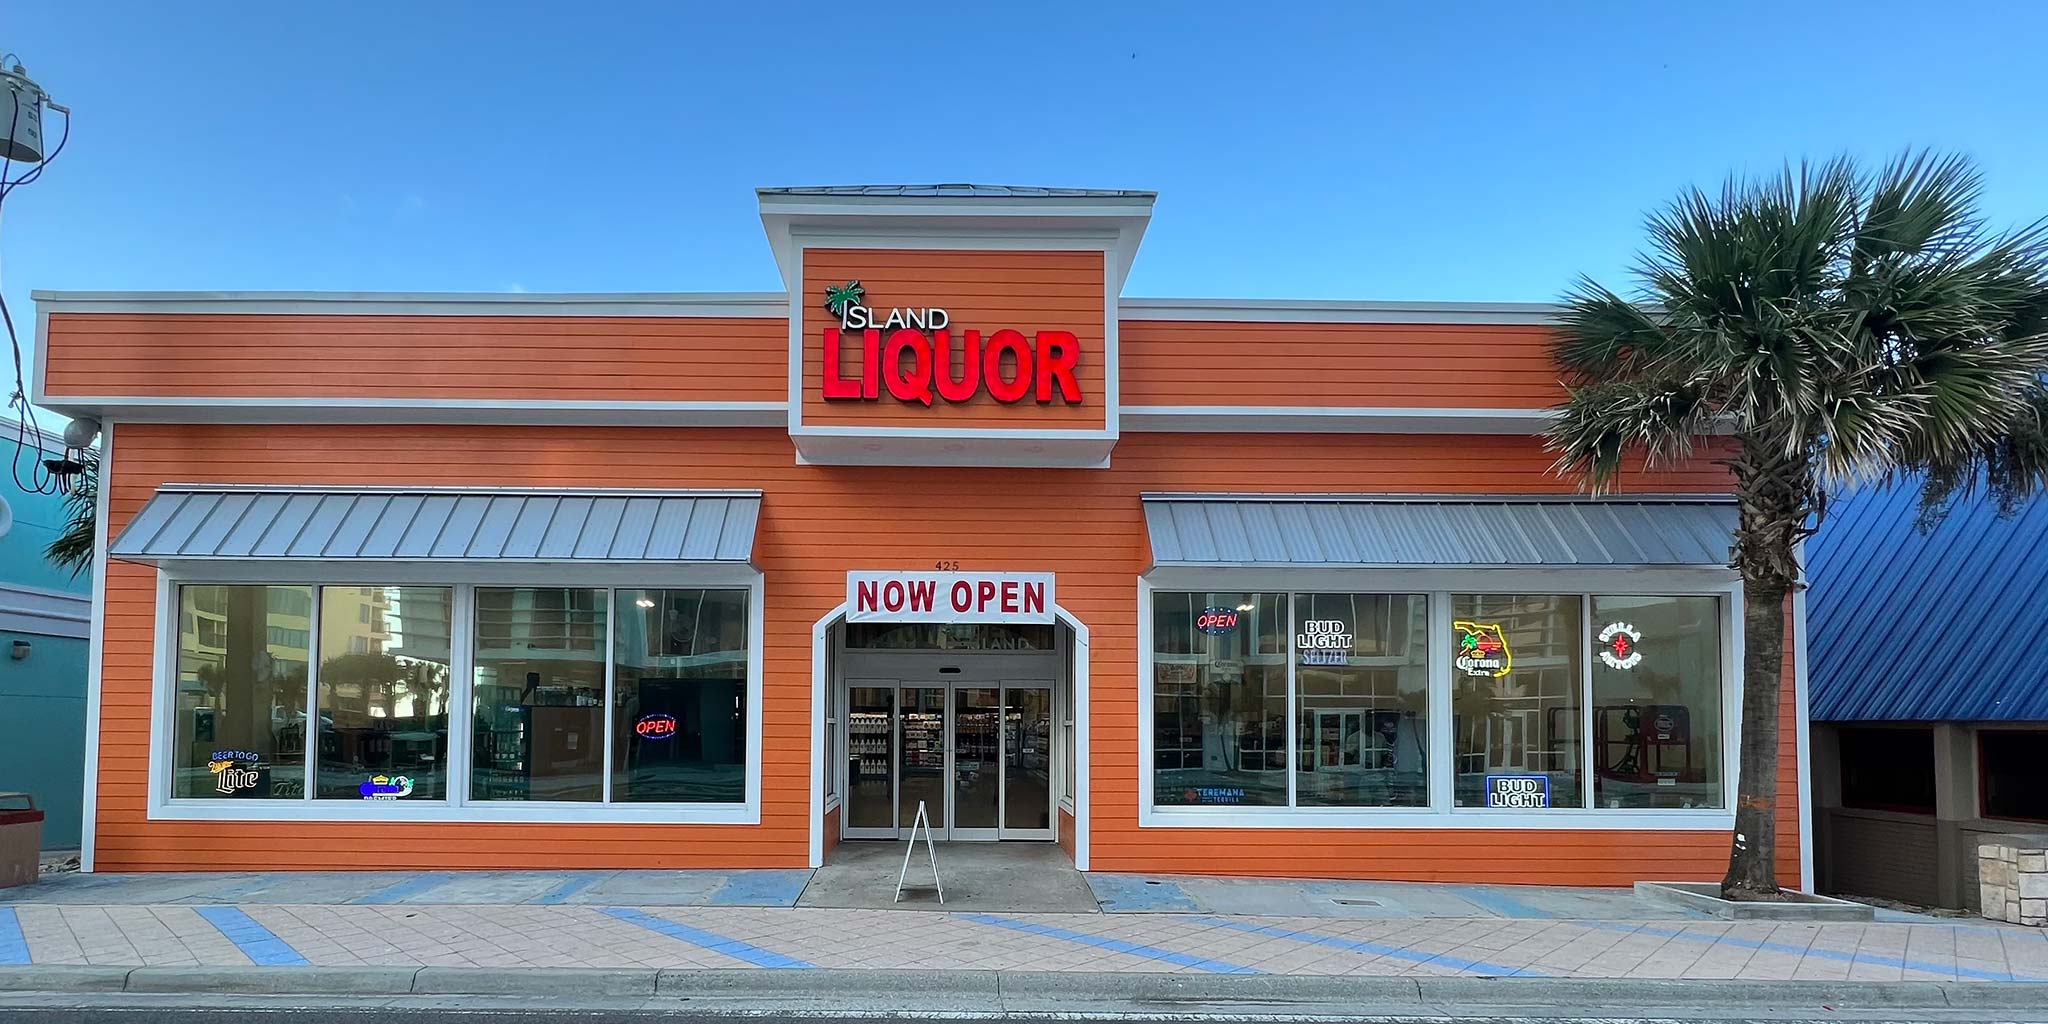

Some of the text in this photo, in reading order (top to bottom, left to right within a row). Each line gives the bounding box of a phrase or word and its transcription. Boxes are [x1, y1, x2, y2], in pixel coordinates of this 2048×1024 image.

[842, 301, 949, 330] ISLAND
[823, 327, 1082, 407] LIQUOR
[935, 561, 959, 571] 425
[857, 580, 1045, 613] NOW OPEN
[1197, 613, 1238, 627] OPEN
[1305, 620, 1345, 635] BUD
[1598, 621, 1642, 643] STELLA
[1297, 634, 1352, 649] LIGHT
[1303, 649, 1349, 665] SELTZER
[1456, 655, 1500, 671] Corona
[1467, 667, 1490, 676] Extra
[636, 720, 676, 734] OPEN
[212, 751, 260, 761] BEER TO GO
[216, 768, 259, 794] Lite
[1497, 779, 1537, 793] BUD
[1490, 792, 1546, 808] LIGHT
